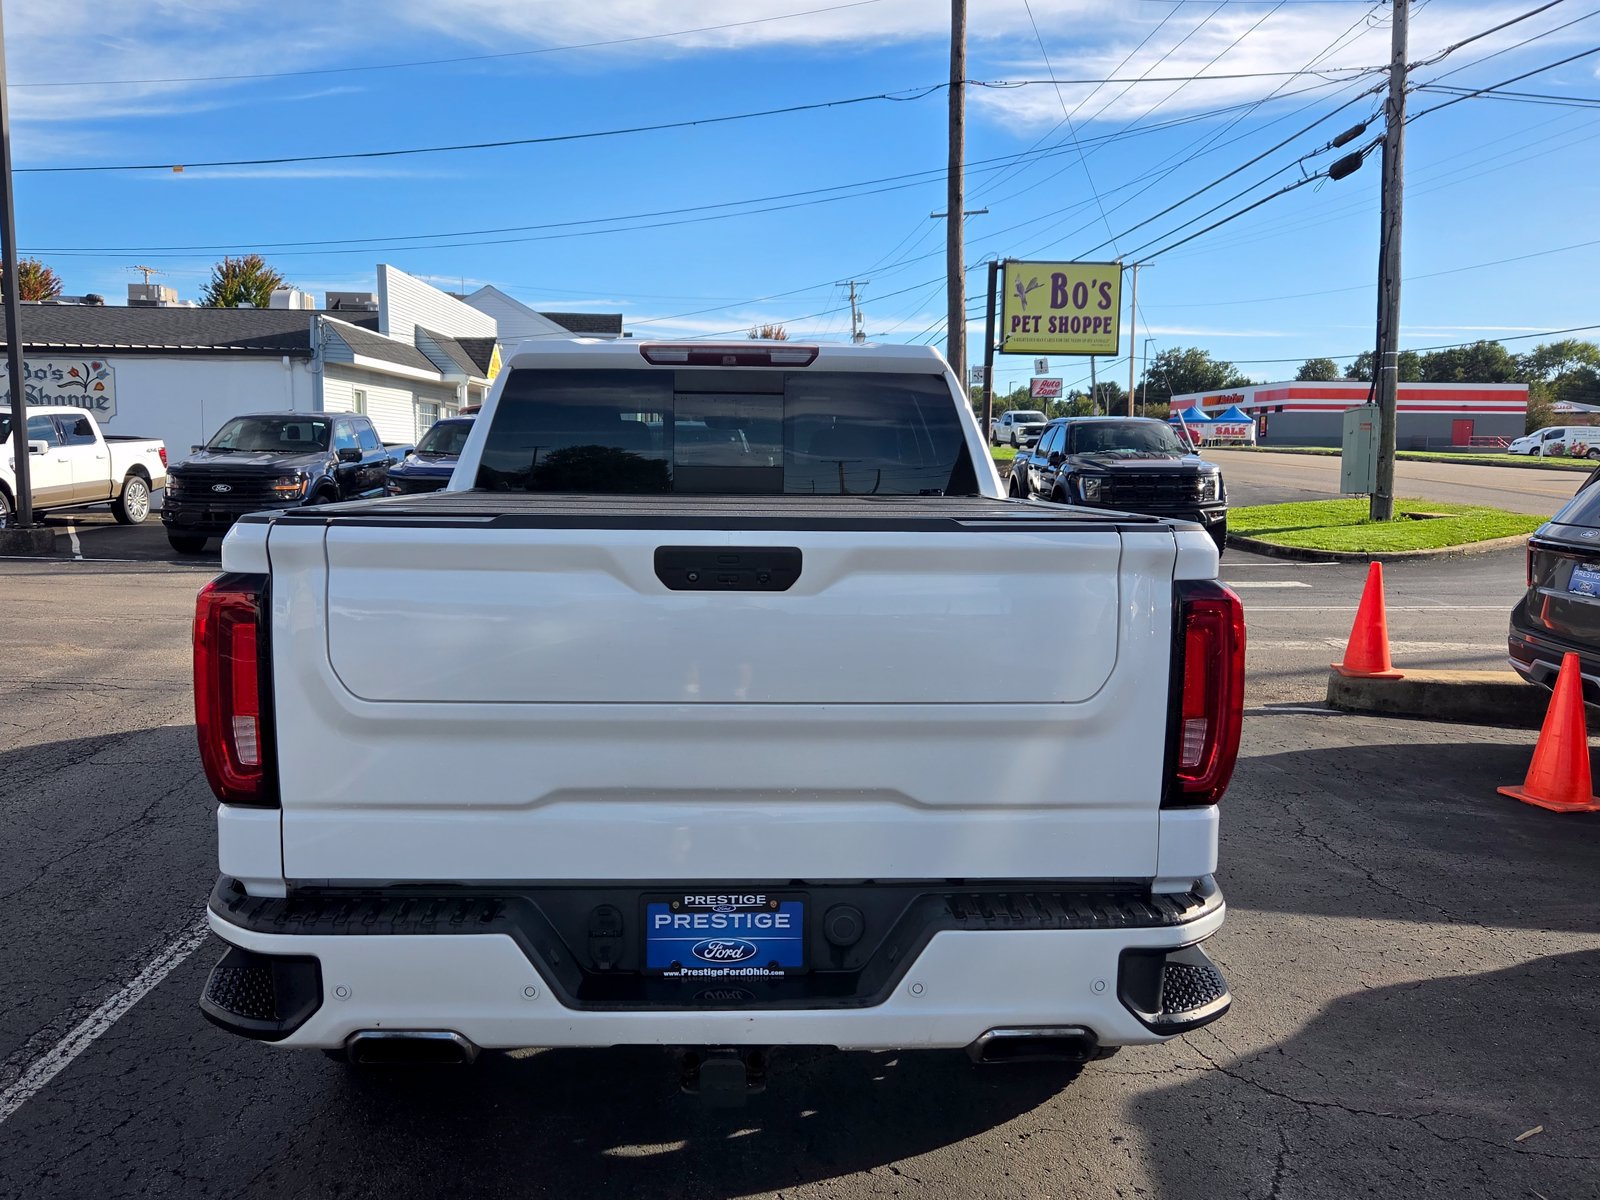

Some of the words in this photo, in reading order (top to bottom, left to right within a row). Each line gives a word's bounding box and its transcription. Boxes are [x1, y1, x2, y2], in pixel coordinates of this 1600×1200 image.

[1011, 315, 1042, 333] PET
[1048, 316, 1112, 334] SHOPPE
[1039, 379, 1061, 388] Auto
[1034, 387, 1057, 396] Zone
[1215, 427, 1246, 436] SALE
[684, 895, 767, 905] PRESTIGE
[655, 913, 791, 929] PRESTIGE
[704, 941, 745, 959] Ford
[663, 967, 785, 978] www.PrestigeFordOhio.com
